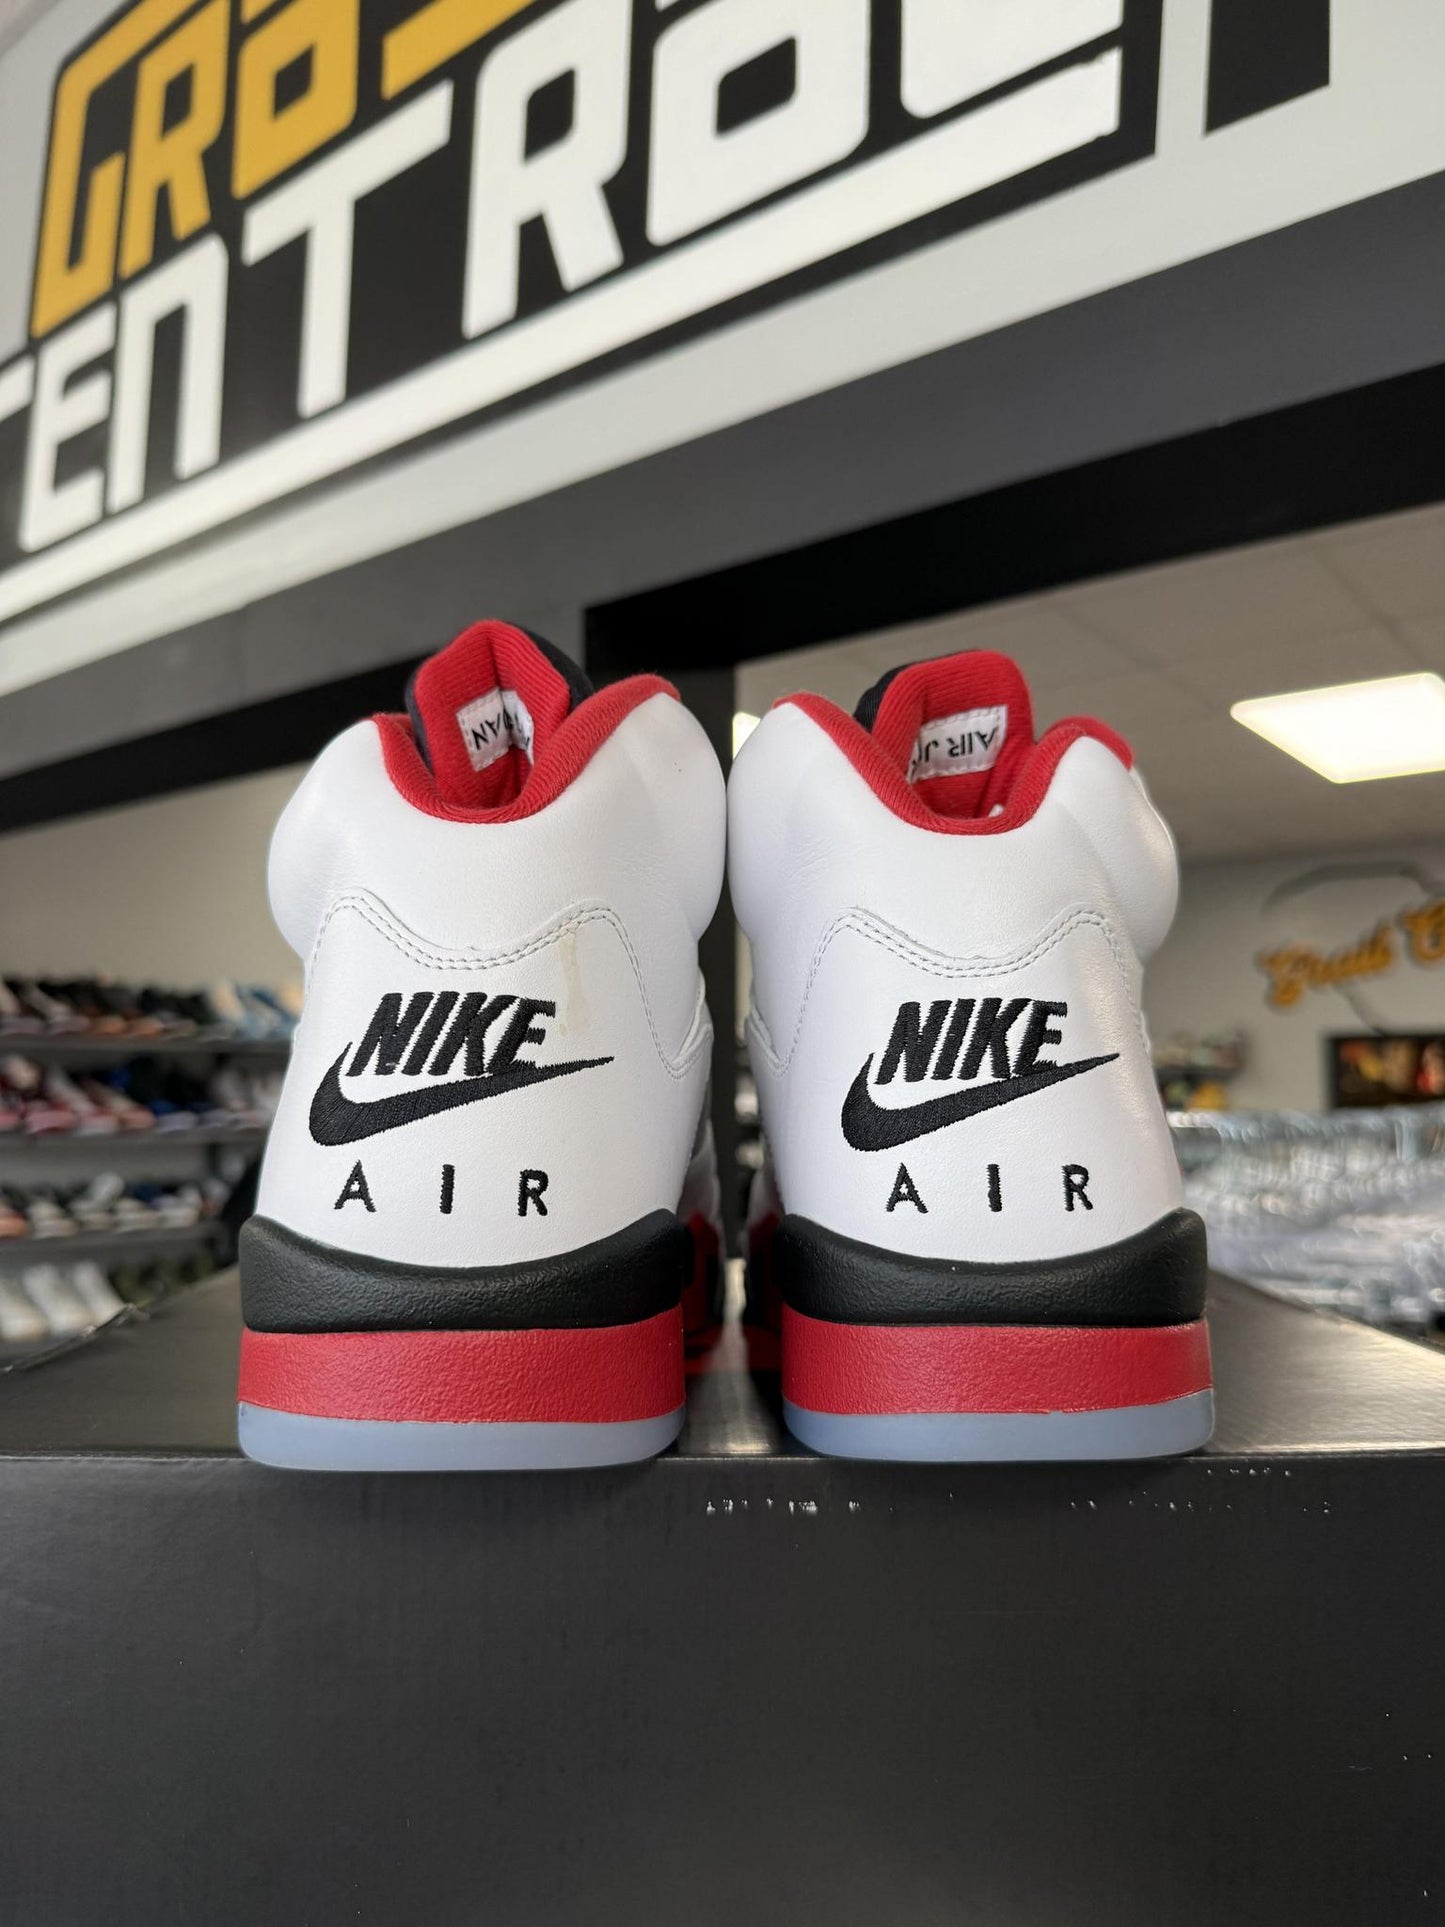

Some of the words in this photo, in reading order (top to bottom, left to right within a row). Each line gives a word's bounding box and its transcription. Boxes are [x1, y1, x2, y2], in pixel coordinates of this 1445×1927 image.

[944, 725, 999, 759] AIR
[345, 990, 556, 1077] NIKE
[874, 997, 1068, 1085] NIKE
[333, 1159, 549, 1217] AIR
[885, 1162, 1093, 1214] AIR
